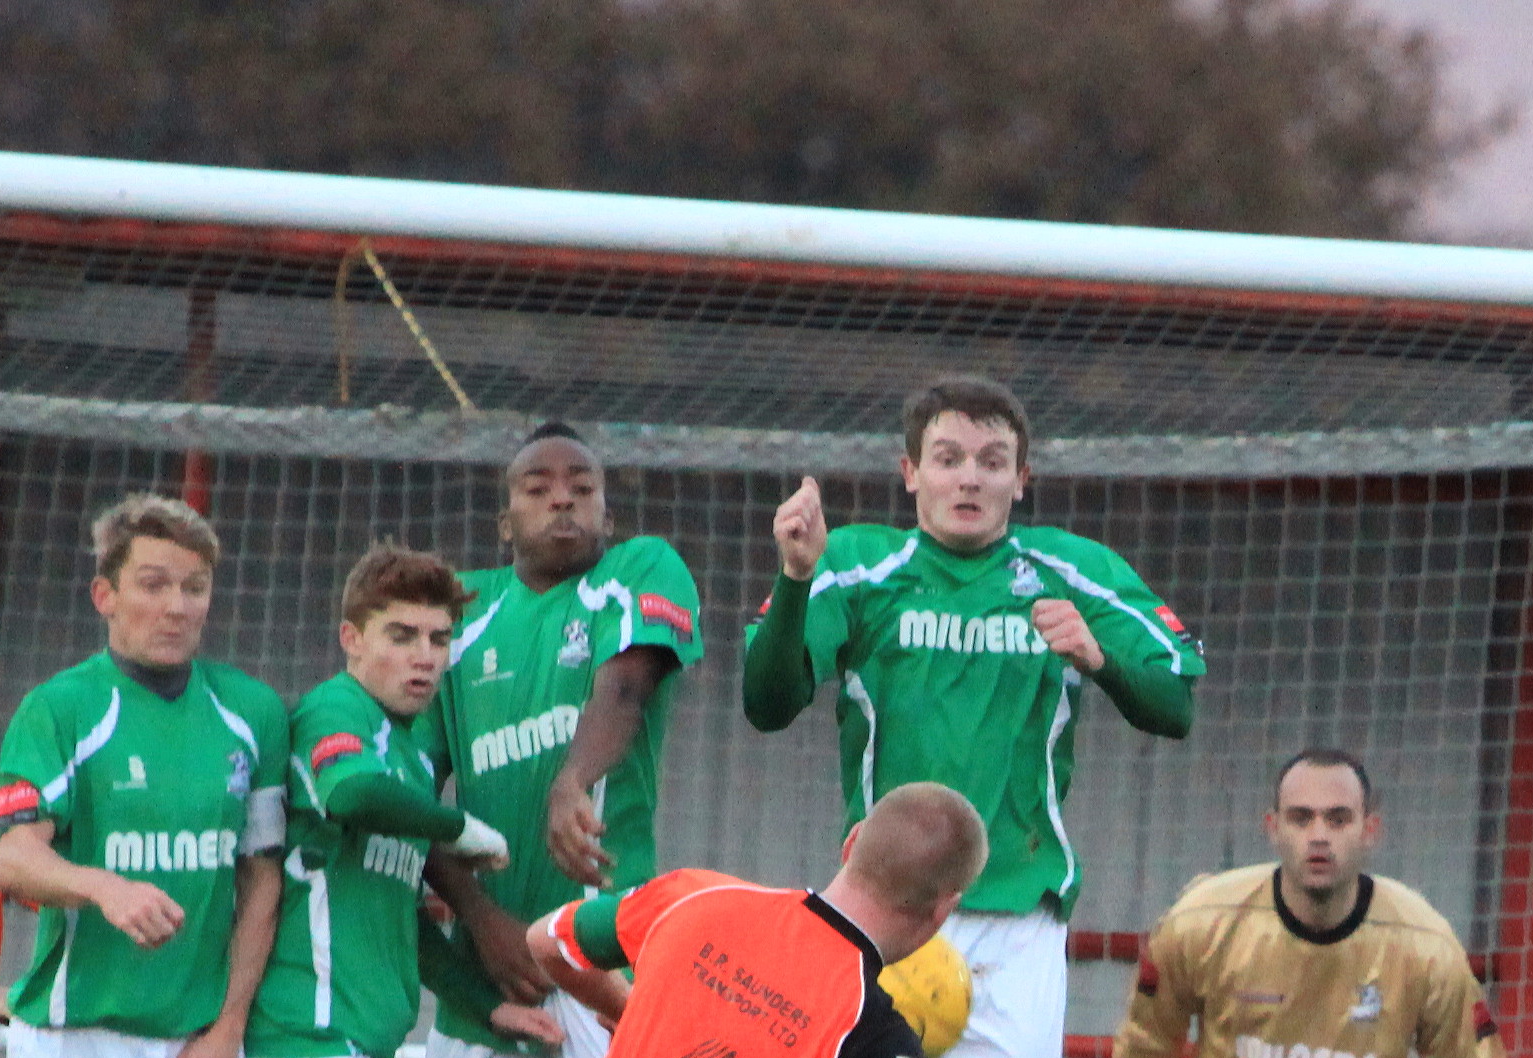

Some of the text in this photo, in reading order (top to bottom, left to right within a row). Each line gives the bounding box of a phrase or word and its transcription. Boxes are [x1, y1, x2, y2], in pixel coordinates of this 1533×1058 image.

[470, 703, 585, 776] MILNER
[731, 967, 812, 1029] SAUNDERS
[768, 1020, 798, 1048] LTD
